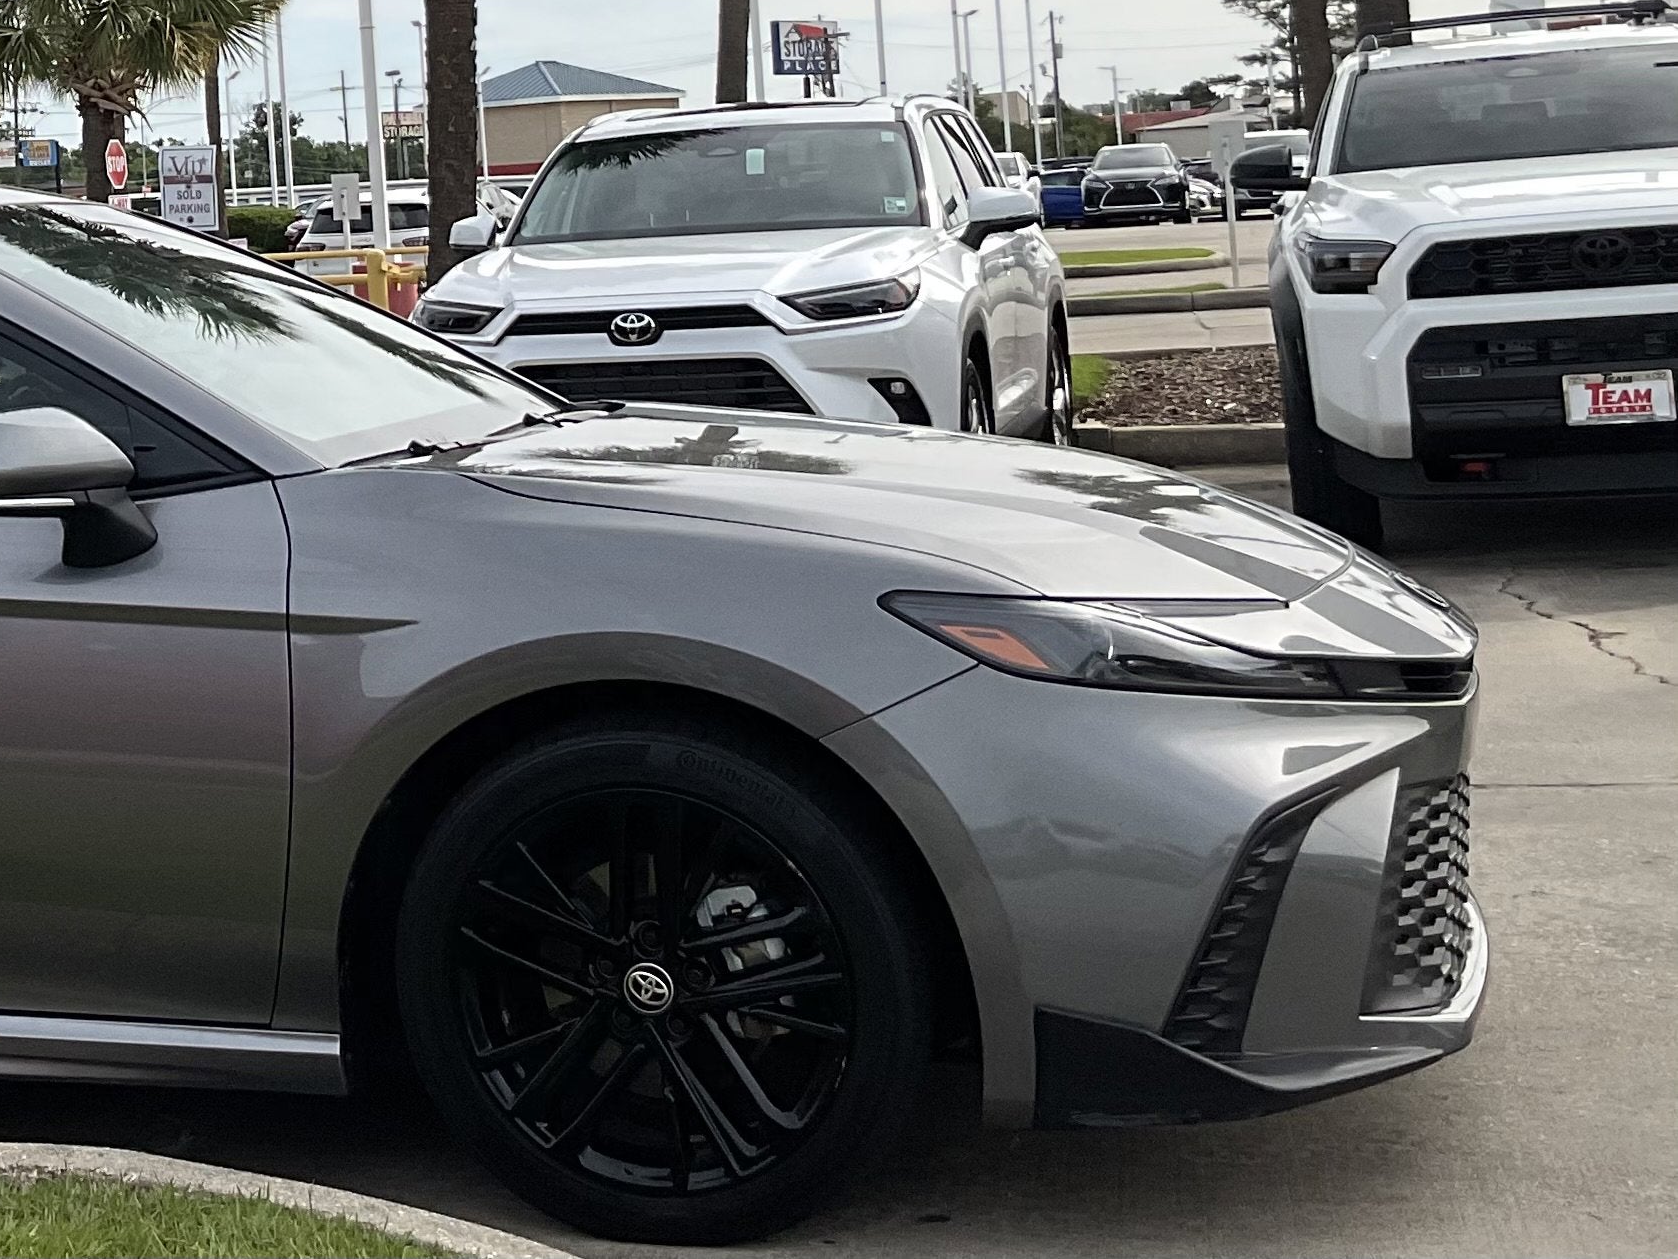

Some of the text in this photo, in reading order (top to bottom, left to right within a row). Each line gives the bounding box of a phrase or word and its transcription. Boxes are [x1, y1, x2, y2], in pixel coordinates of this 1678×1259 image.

[107, 155, 125, 173] STOP
[176, 190, 202, 200] SOLD
[169, 203, 210, 214] PARKING
[1584, 383, 1652, 407] TEAM
